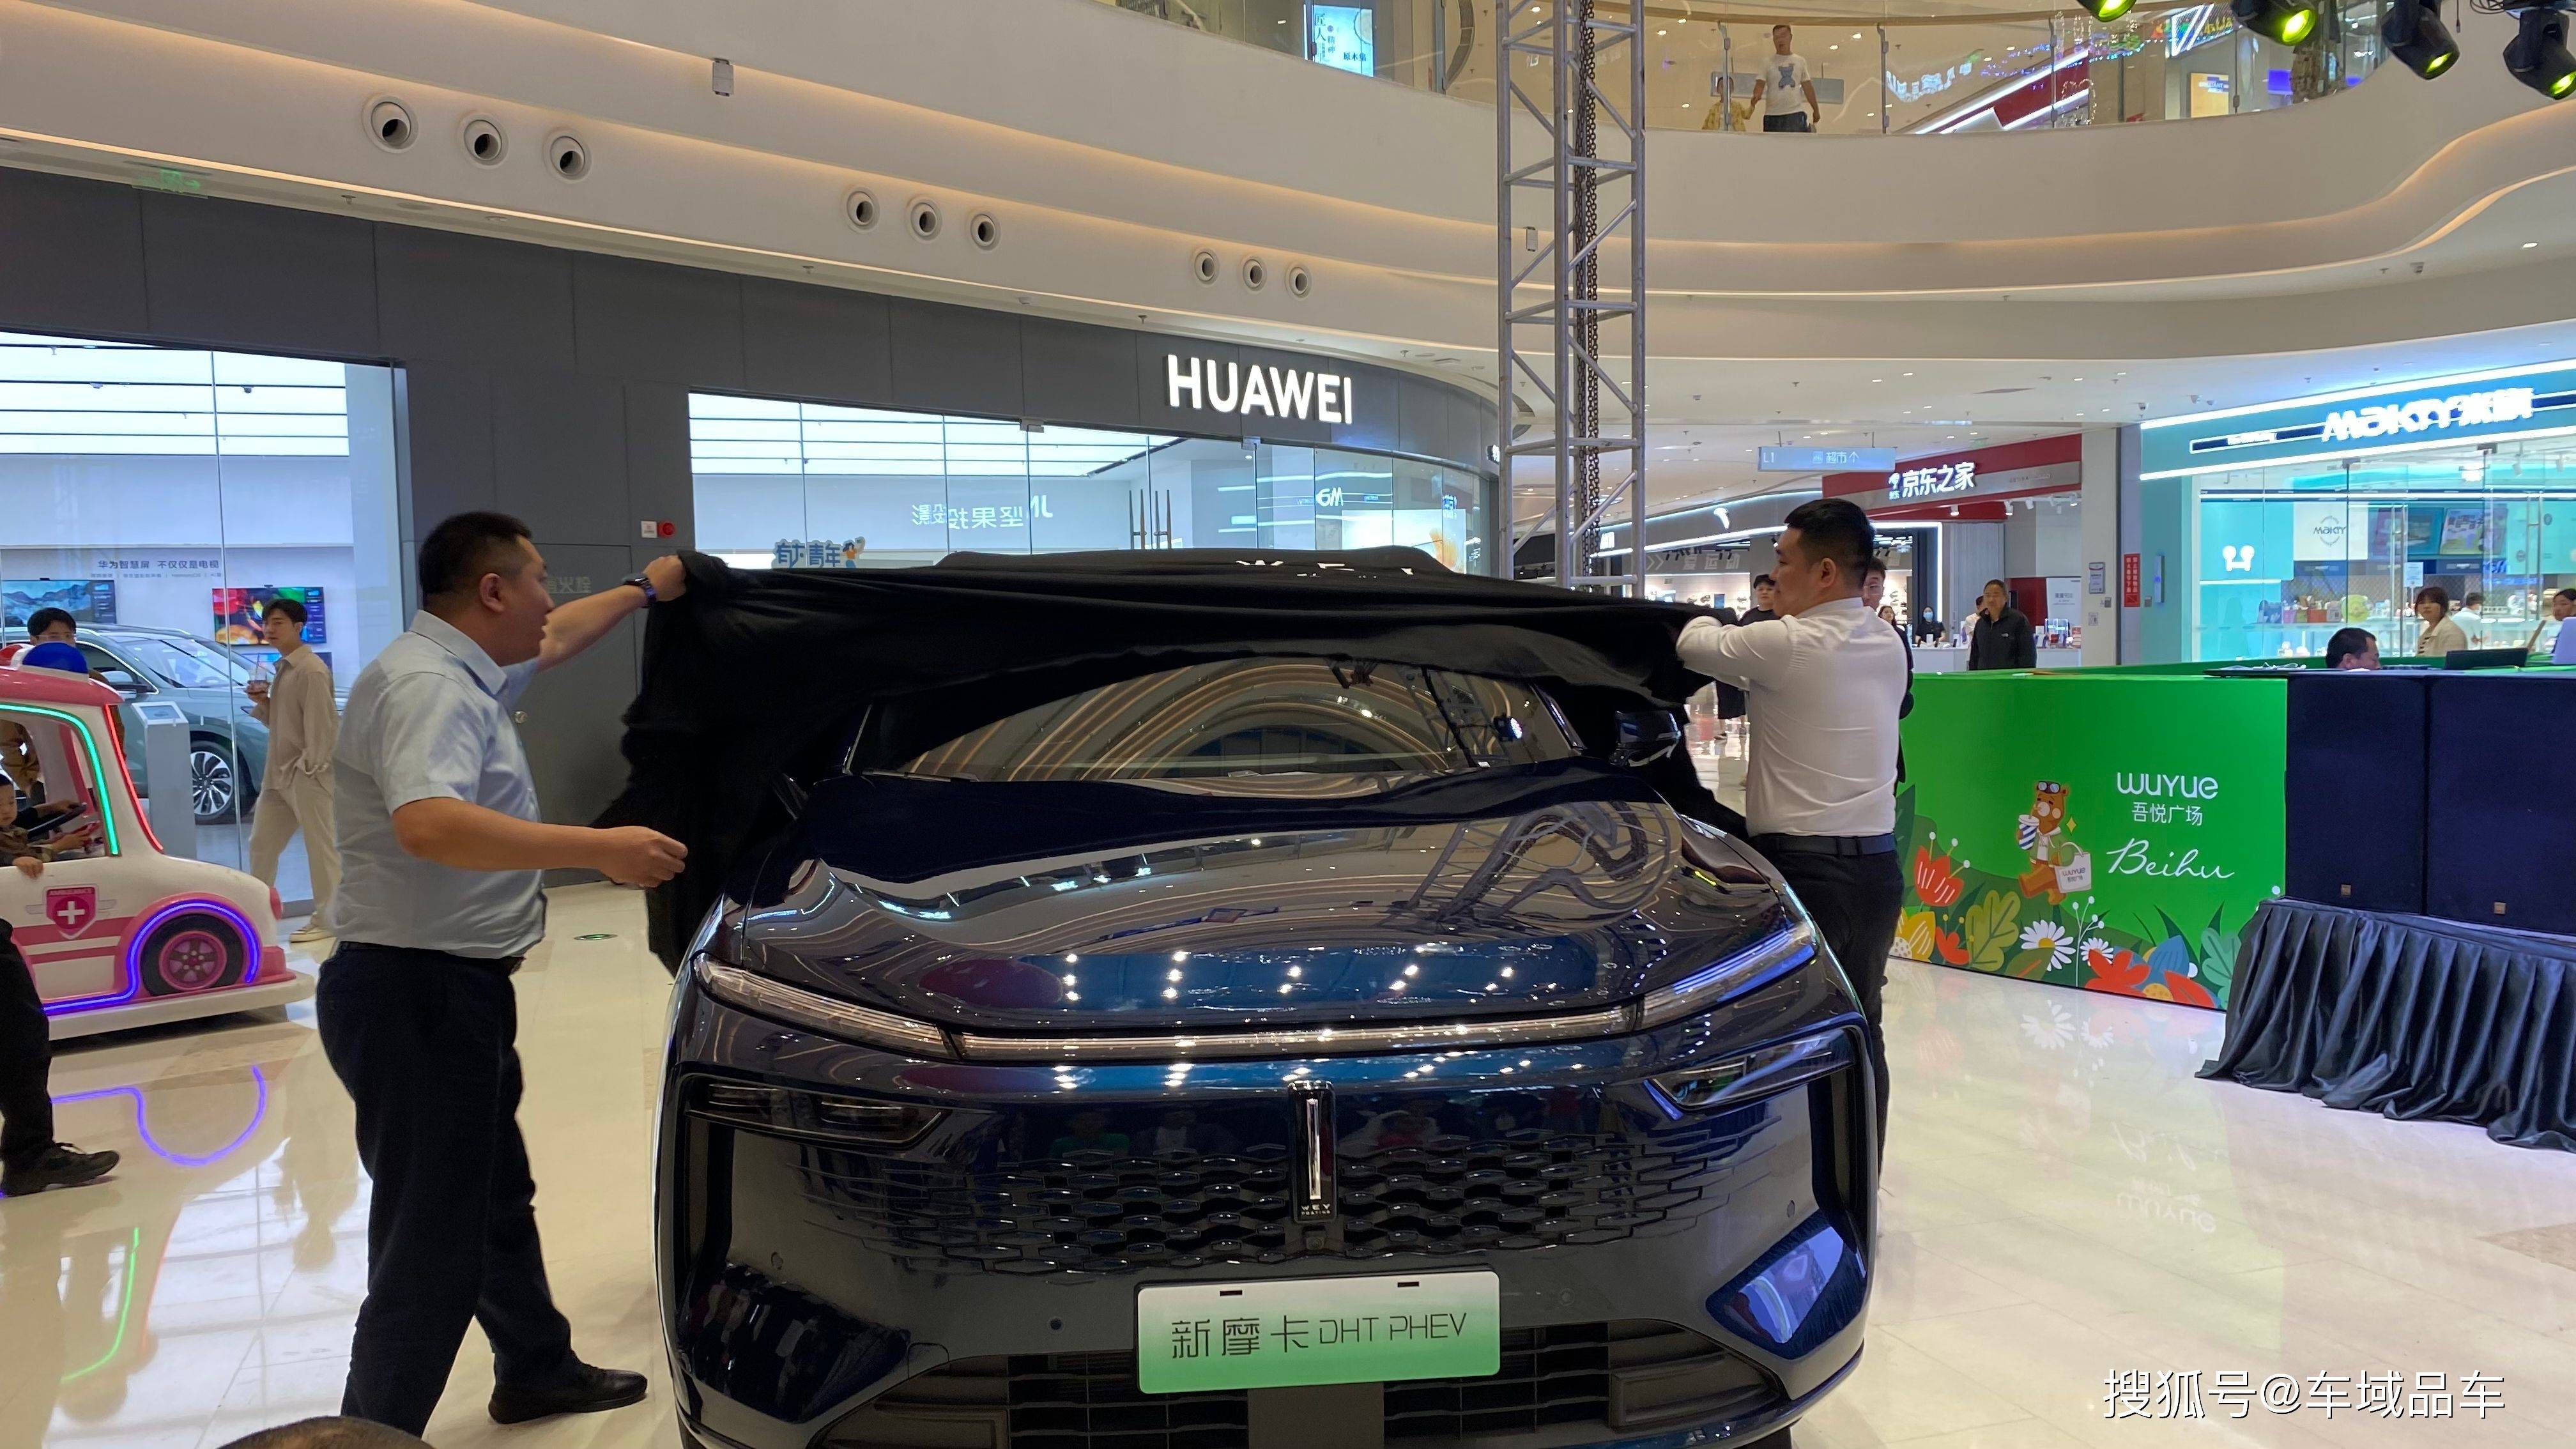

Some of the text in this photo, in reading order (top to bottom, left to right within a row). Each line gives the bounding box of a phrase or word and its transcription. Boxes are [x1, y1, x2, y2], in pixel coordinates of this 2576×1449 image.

[1168, 354, 1353, 424] HUAWEI
[1763, 451, 1848, 464] L1 超市
[1902, 461, 1975, 498] 京东之家
[98, 560, 220, 569] 华为智慧屏 不仅仅是电视
[2131, 801, 2203, 826] 吾悦广场
[2106, 838, 2235, 878] Beihu
[1172, 1312, 1468, 1359] 新摩卡 DHT PHEV
